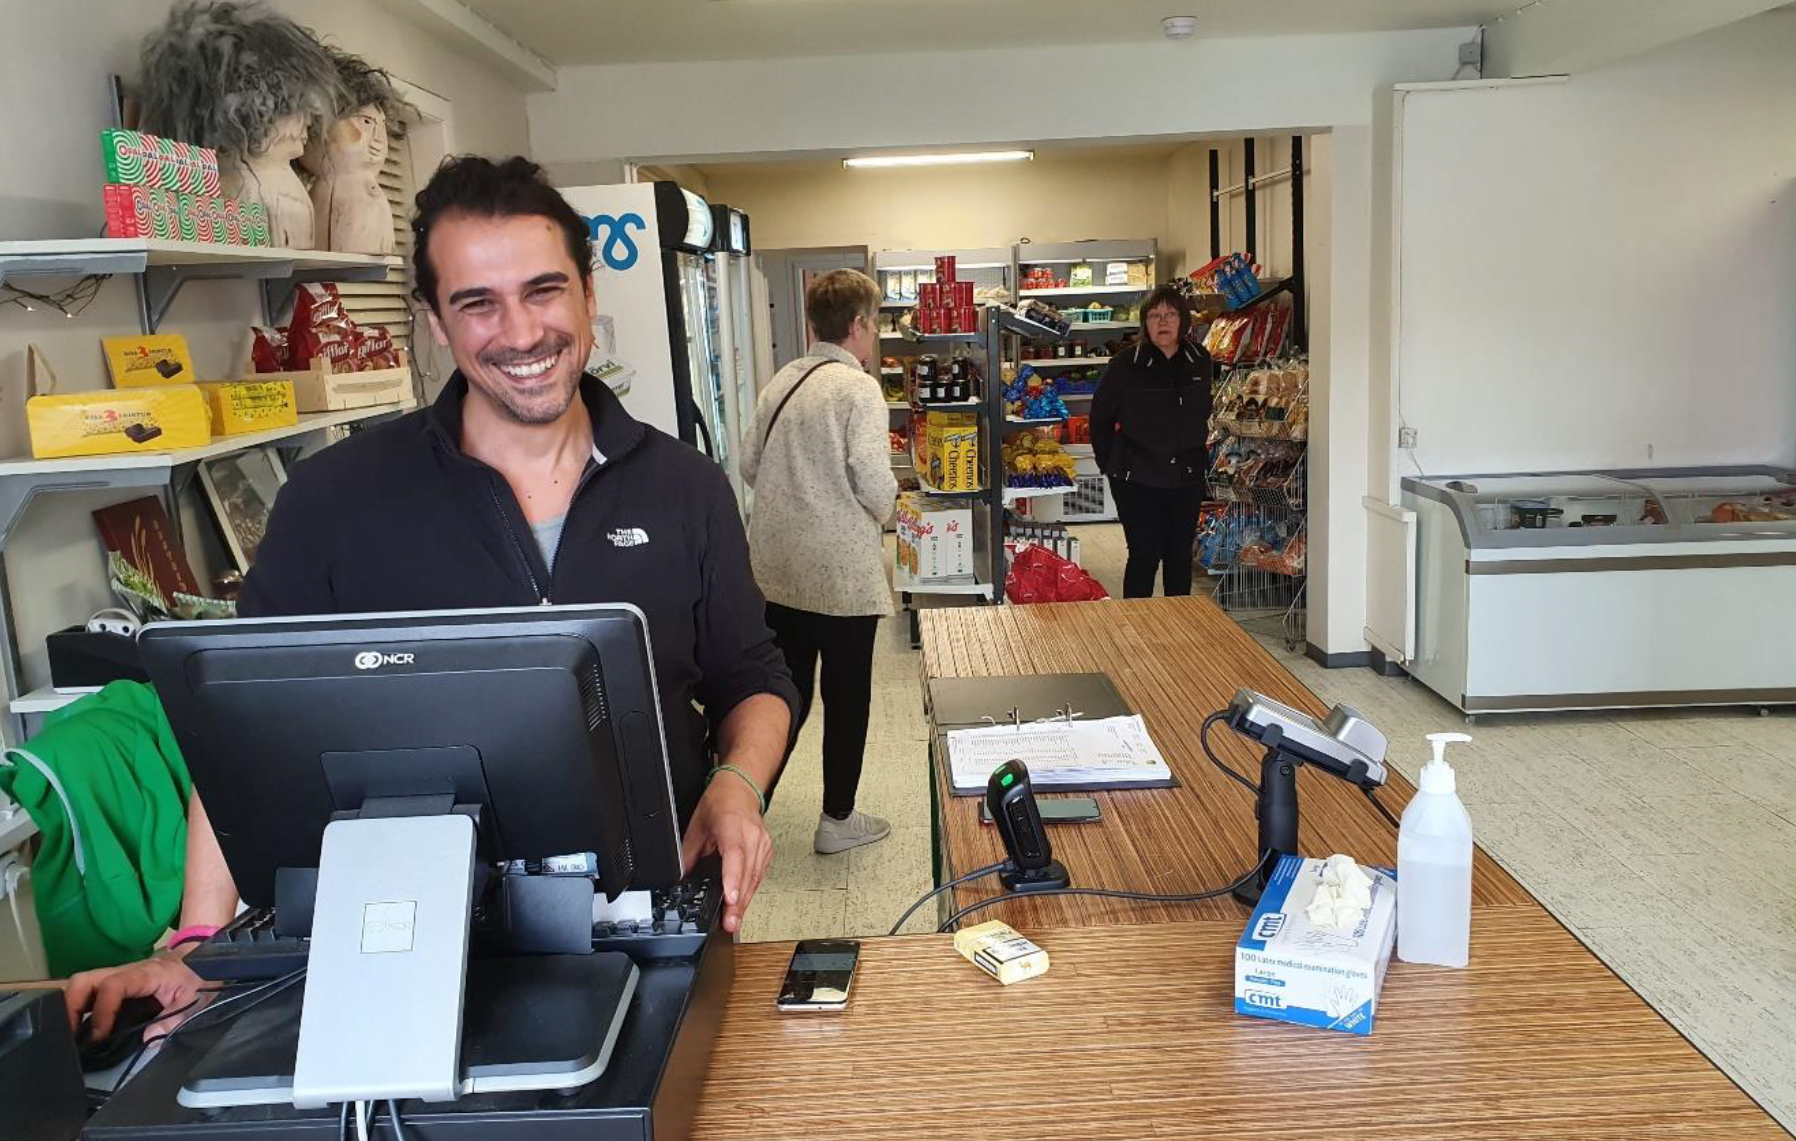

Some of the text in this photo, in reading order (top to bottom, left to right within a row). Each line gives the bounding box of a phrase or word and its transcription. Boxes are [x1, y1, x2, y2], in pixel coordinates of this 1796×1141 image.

[948, 450, 960, 490] Cheerios
[383, 653, 414, 665] NCR
[1258, 916, 1282, 938] cmt
[1241, 952, 1368, 980] 100 Latex medical examination gloves
[1255, 968, 1276, 978] Large
[1249, 992, 1281, 1008] cmt
